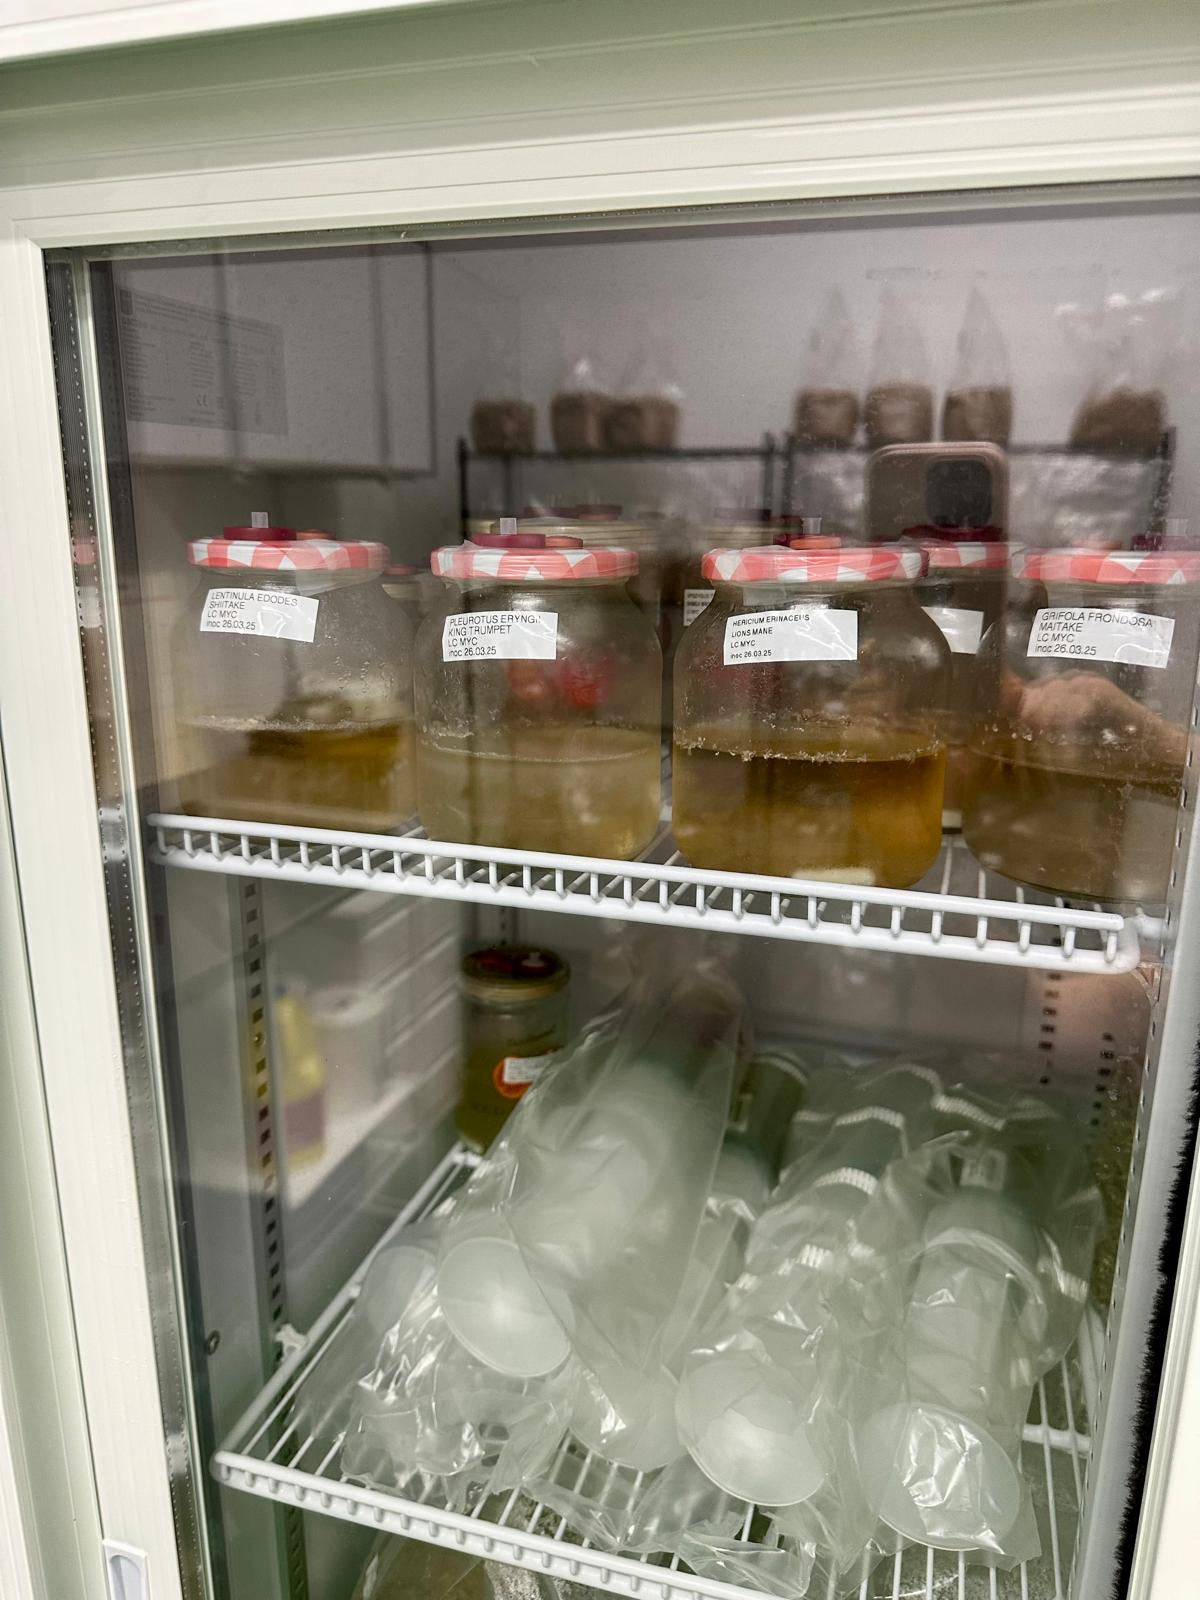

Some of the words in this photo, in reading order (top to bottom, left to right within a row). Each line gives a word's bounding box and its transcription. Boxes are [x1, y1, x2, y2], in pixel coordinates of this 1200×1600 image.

[211, 591, 254, 601] LENTINULA
[257, 593, 298, 607] EDODES
[209, 601, 245, 609] SHIITAKE
[208, 610, 217, 618] LC
[220, 610, 238, 618] MYC
[1041, 611, 1085, 621] GRIFOLA
[1088, 613, 1153, 627] FRONDOSA
[222, 620, 256, 630] 26.03.25
[450, 615, 498, 626] PLEUROTUS
[733, 617, 765, 627] HERICIUM
[448, 627, 467, 637] KING
[469, 625, 512, 635] TRUMPET
[731, 629, 751, 638] LIONS
[752, 627, 773, 635] MANE
[1039, 622, 1083, 633] MAITAKE
[448, 639, 458, 647] LC
[460, 637, 478, 646] MYC
[1037, 633, 1049, 643] LC
[1050, 633, 1075, 643] MYC
[730, 641, 739, 649] LC
[1053, 644, 1097, 656] 26.03.25
[464, 646, 496, 656] 26.03.25
[744, 650, 772, 658] 26.03.25
